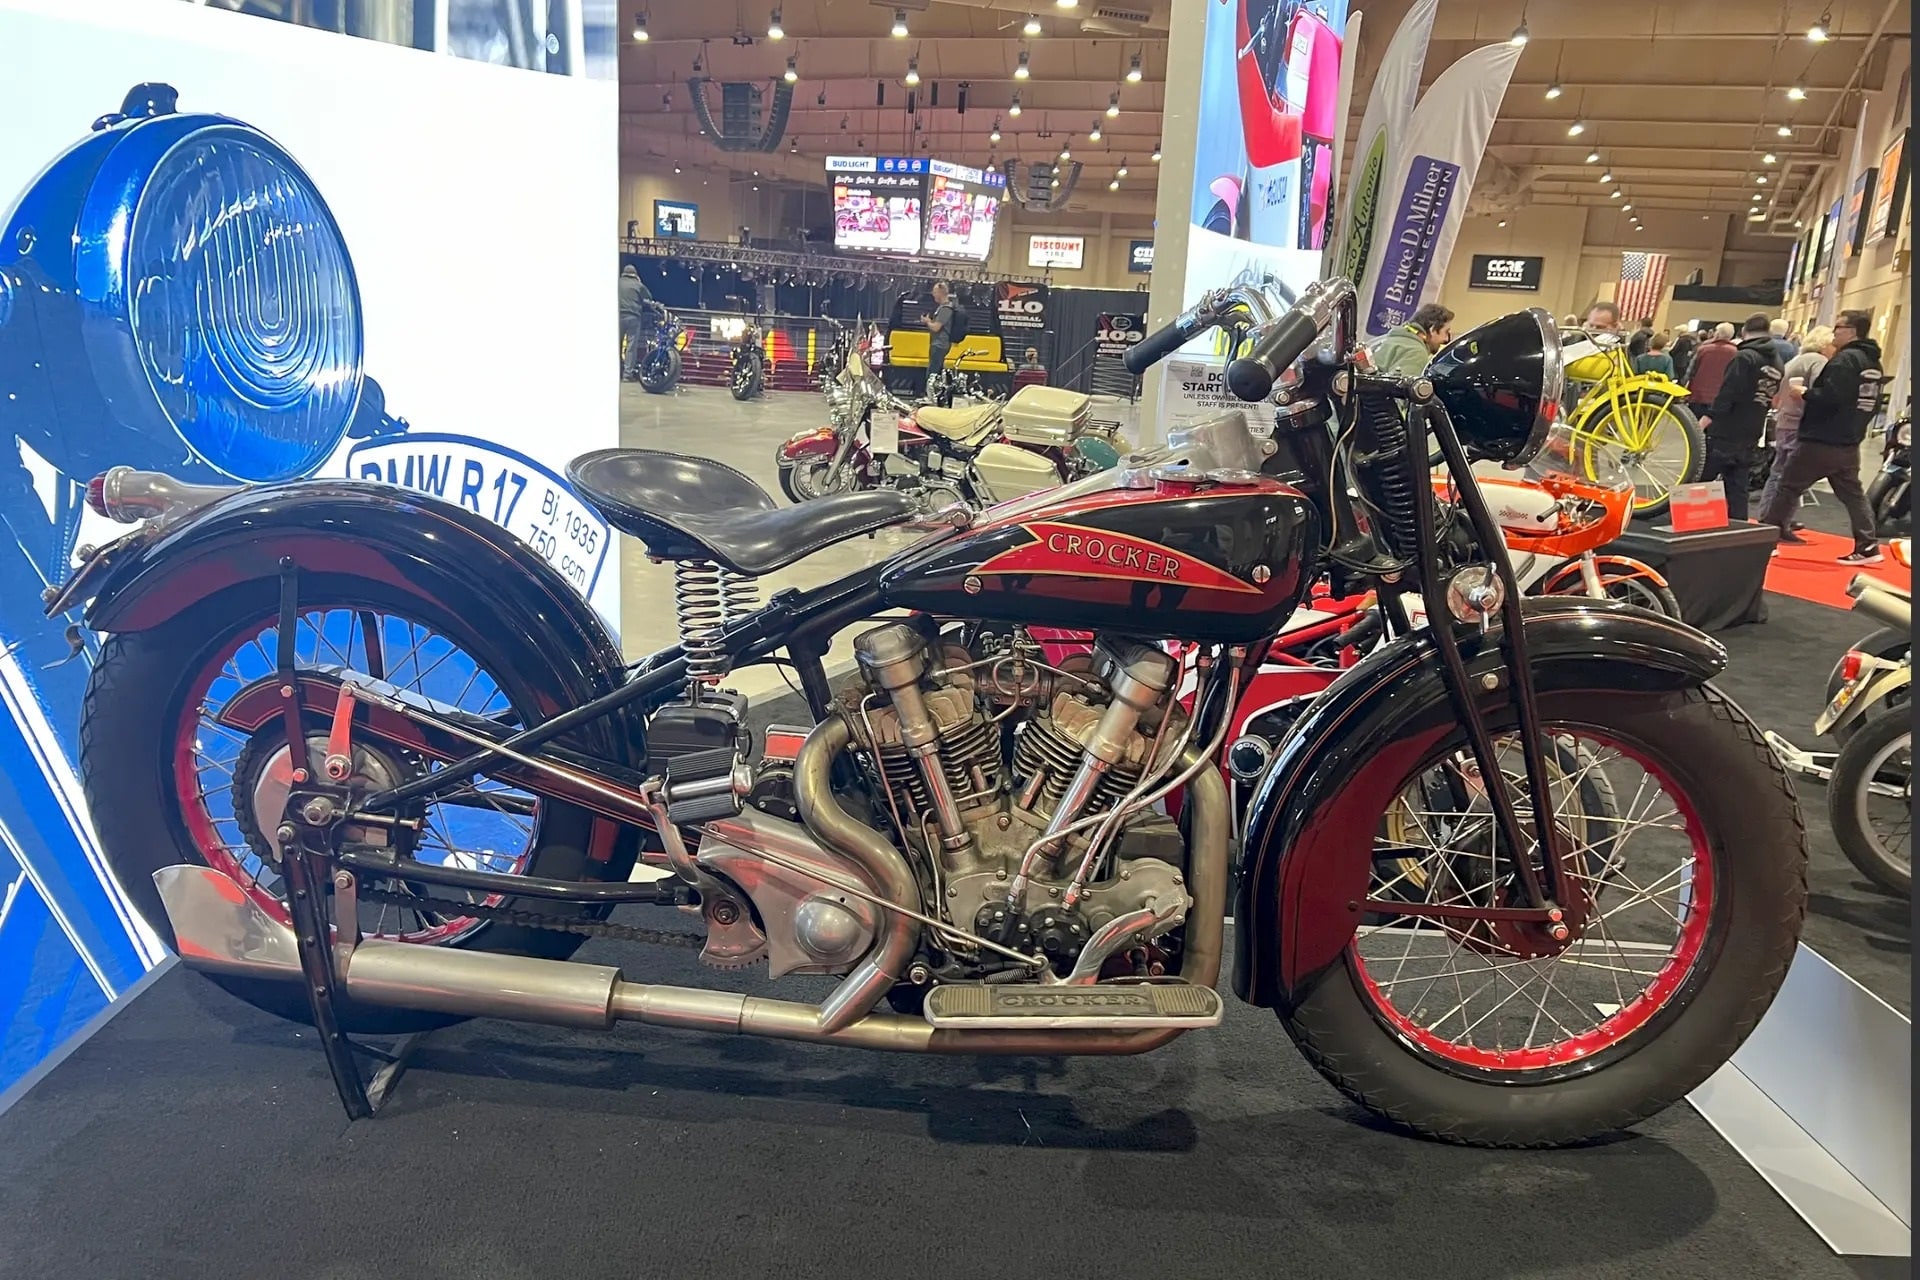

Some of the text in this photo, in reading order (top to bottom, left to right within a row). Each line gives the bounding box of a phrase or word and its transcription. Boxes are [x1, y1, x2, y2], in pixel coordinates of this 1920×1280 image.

[832, 160, 869, 169] BUD LIGHT
[1353, 157, 1378, 248] Antonio
[1032, 241, 1080, 251] DISCOUNT
[1385, 162, 1442, 303] Bruce D. Milner
[1405, 170, 1453, 306] COLLECTION
[998, 299, 1044, 314] 110
[1096, 330, 1143, 342] 109
[1182, 382, 1222, 393] START
[460, 458, 488, 514] R
[493, 468, 528, 529] 17
[541, 488, 598, 555] Bj. 1935
[527, 523, 587, 587] 750 ccm
[1047, 532, 1181, 579] CROCKER
[1236, 742, 1262, 756] DOHC
[1001, 994, 1143, 1006] CROCKER
